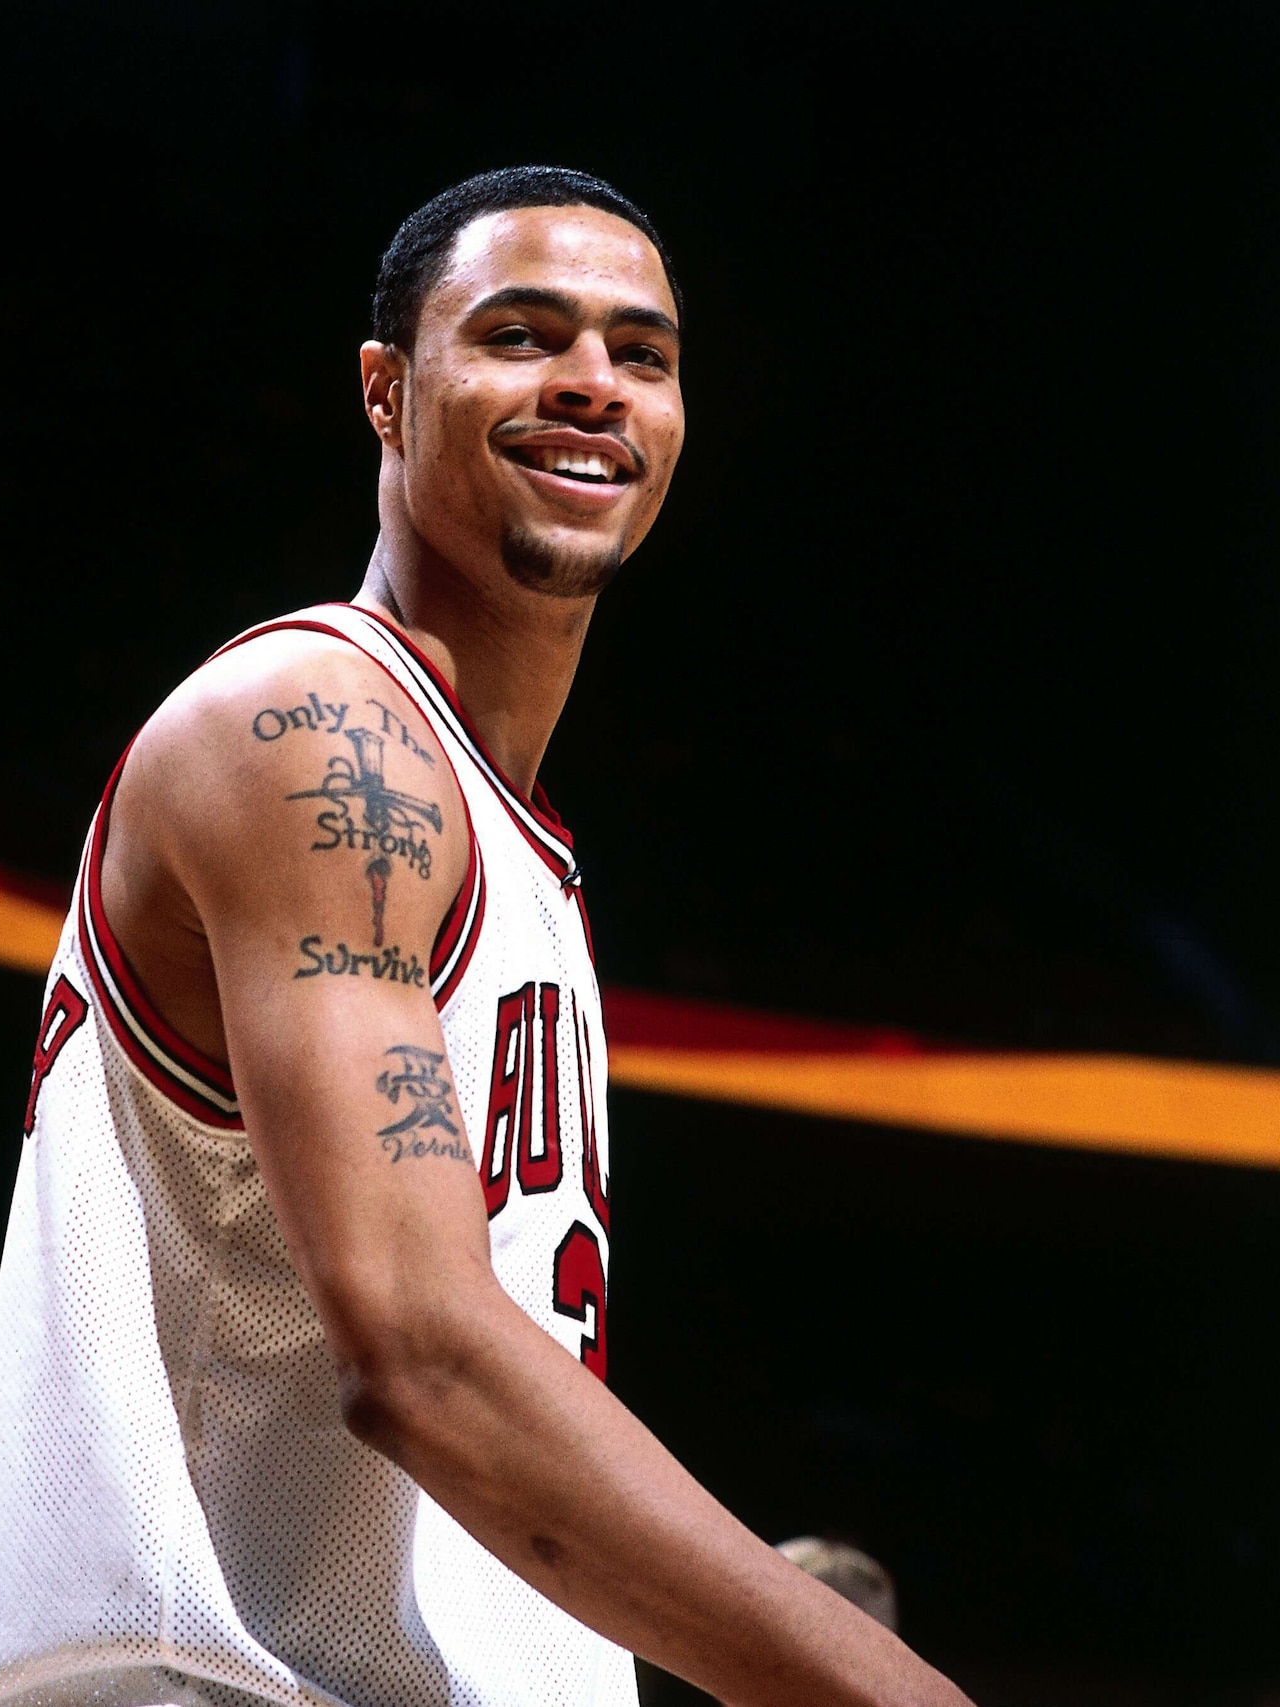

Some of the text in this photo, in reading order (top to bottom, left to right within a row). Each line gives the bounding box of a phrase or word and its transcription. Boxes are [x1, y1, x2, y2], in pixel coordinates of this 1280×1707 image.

[252, 693, 436, 770] Only The
[310, 811, 431, 880] Strong
[294, 934, 425, 988] Survive
